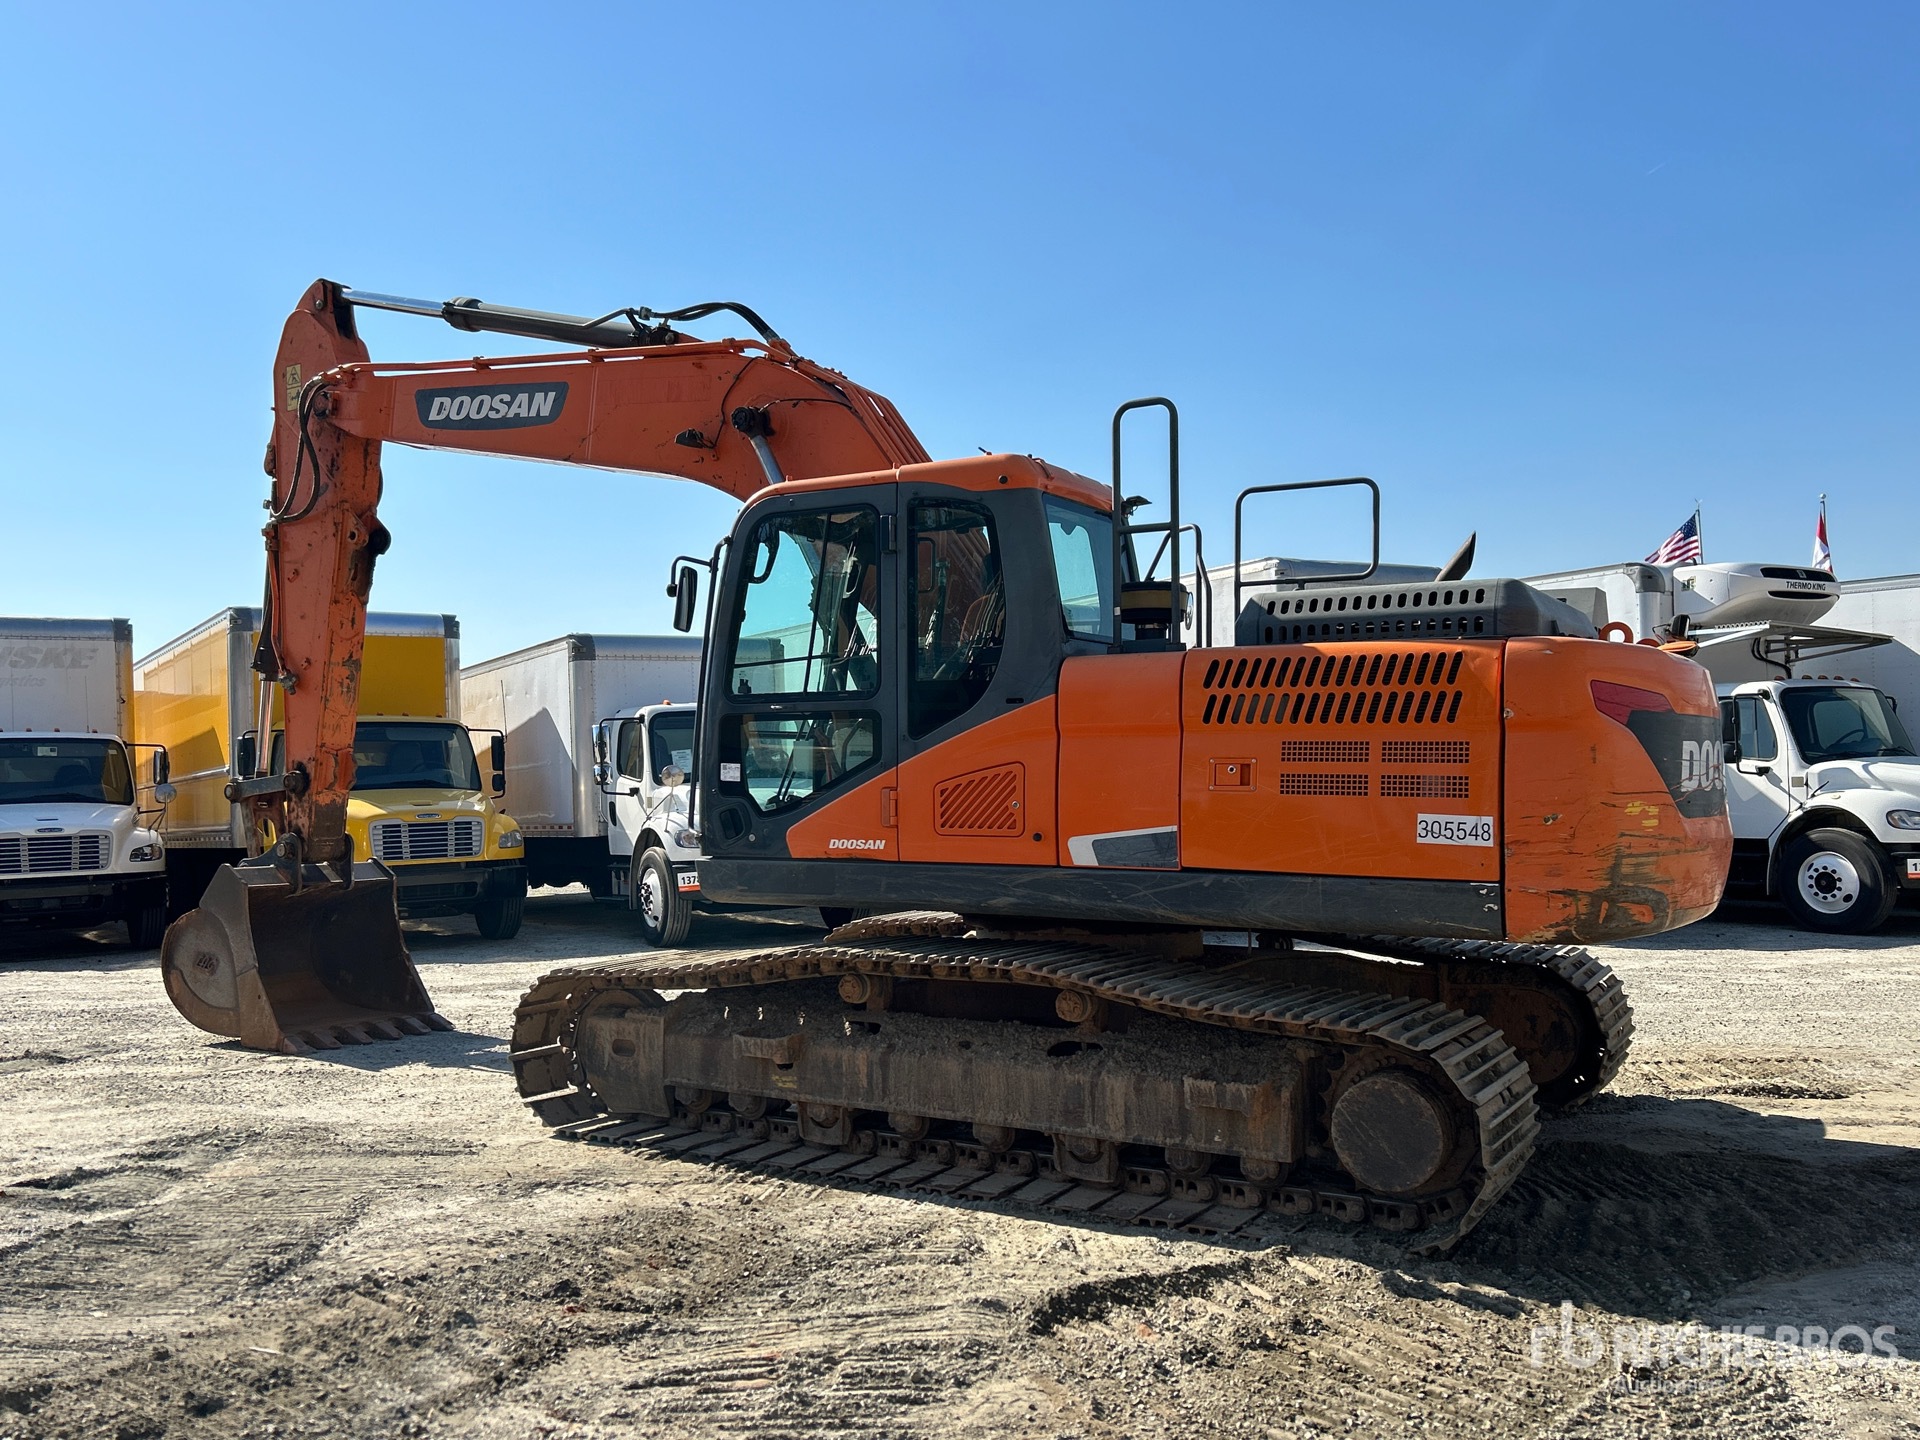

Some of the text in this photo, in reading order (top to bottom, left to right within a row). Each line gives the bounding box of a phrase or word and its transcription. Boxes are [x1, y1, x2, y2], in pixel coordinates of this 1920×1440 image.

[428, 391, 556, 421] DOOSAN
[1786, 580, 1826, 591] THERMO KING
[1418, 819, 1491, 842] 305548
[829, 838, 886, 850] DOOSAN
[1912, 862, 1920, 872] 1
[681, 875, 700, 885] 137
